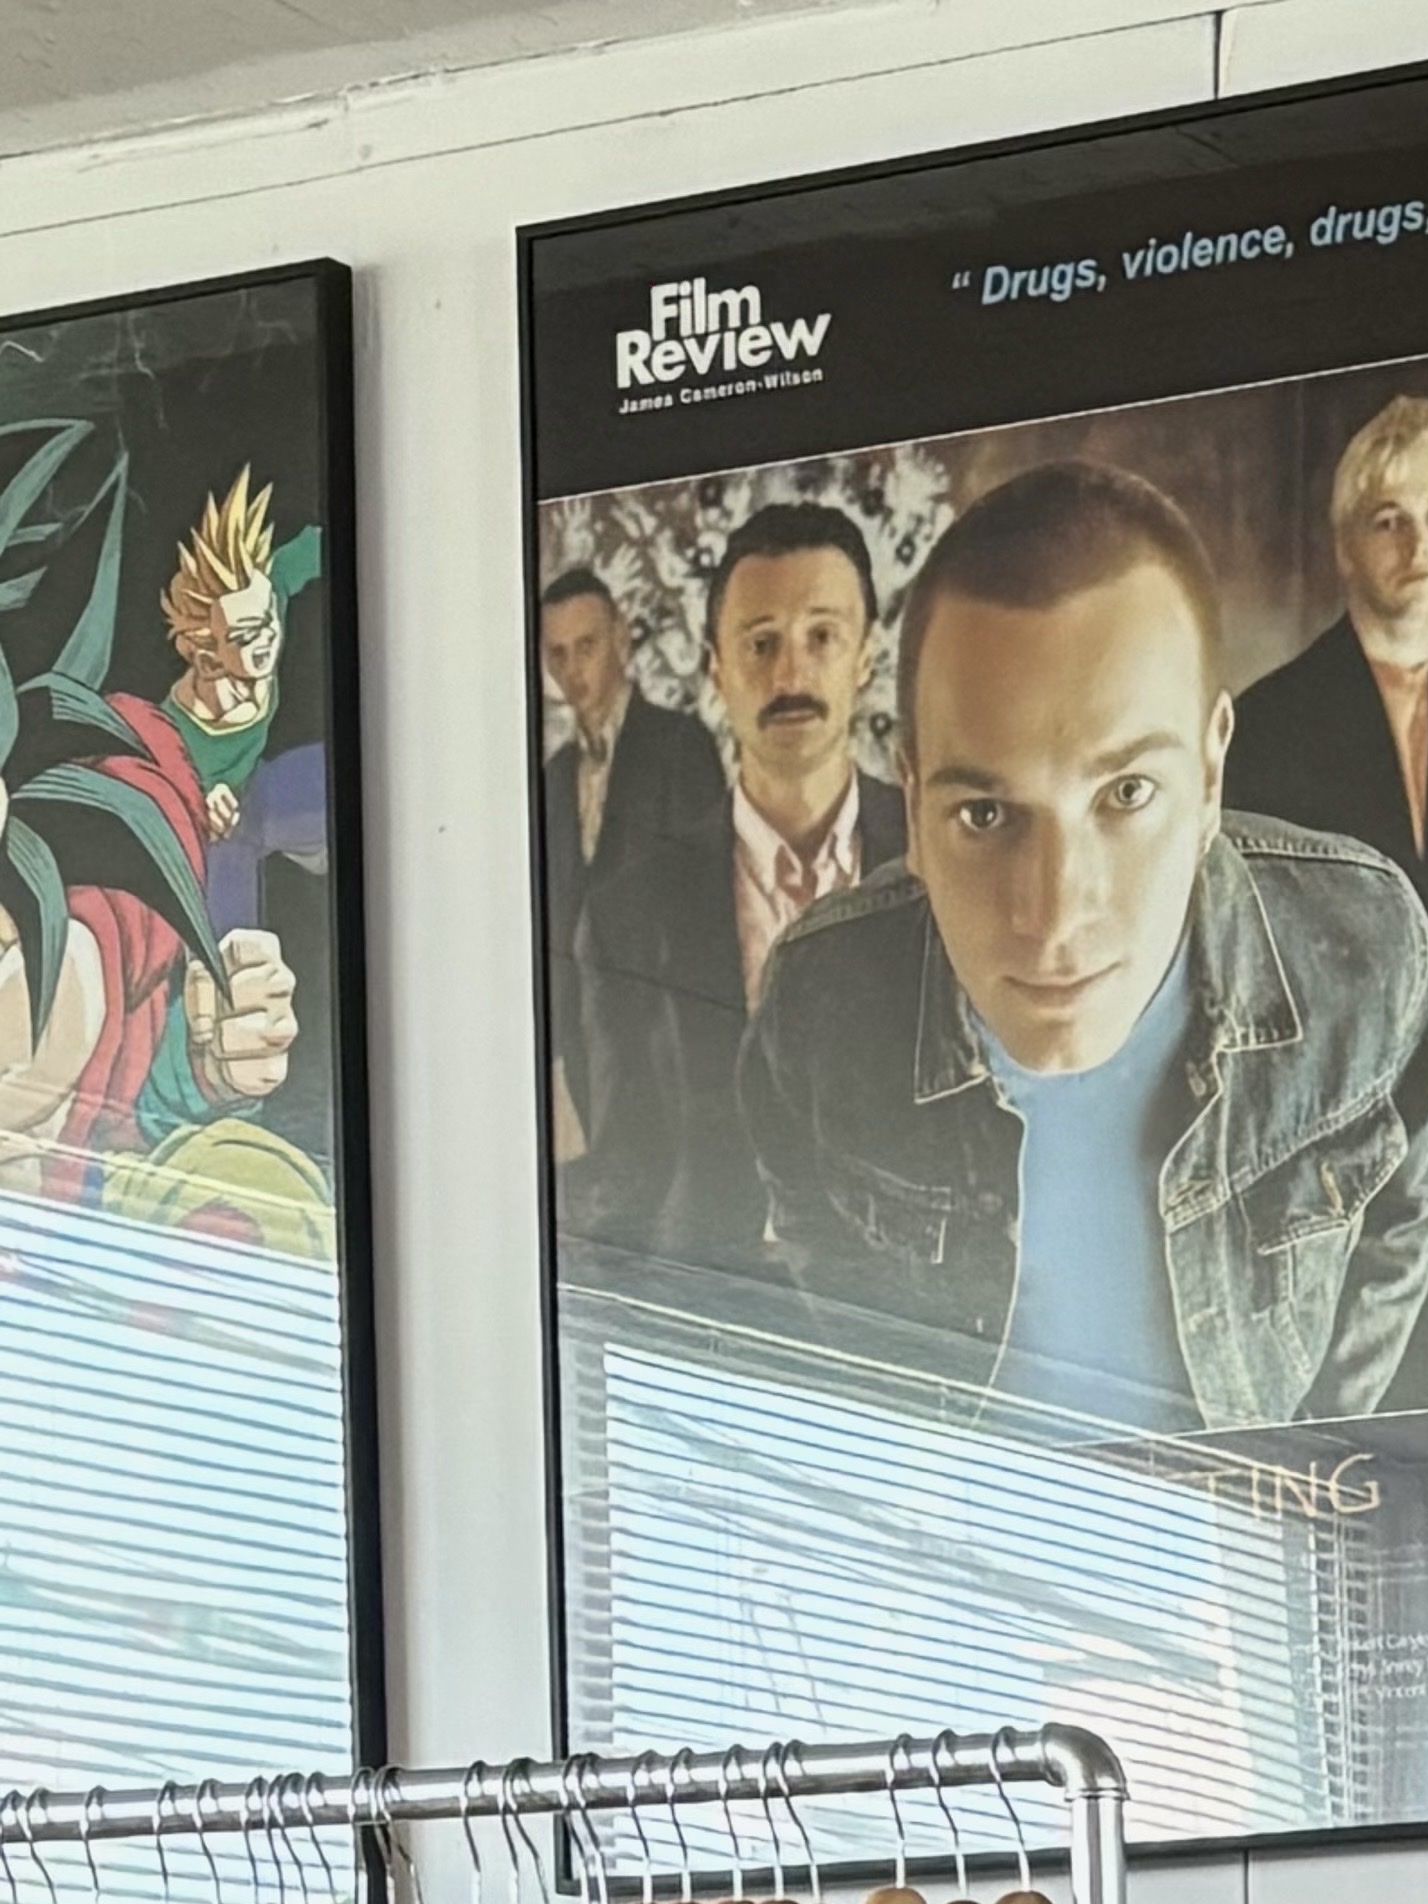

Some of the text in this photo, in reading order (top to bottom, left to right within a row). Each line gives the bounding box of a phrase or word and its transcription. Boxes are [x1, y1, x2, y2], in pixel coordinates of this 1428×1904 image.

[1121, 223, 1295, 281] violence,
[650, 276, 762, 342] Film
[616, 312, 832, 390] Review
[618, 394, 673, 415] James
